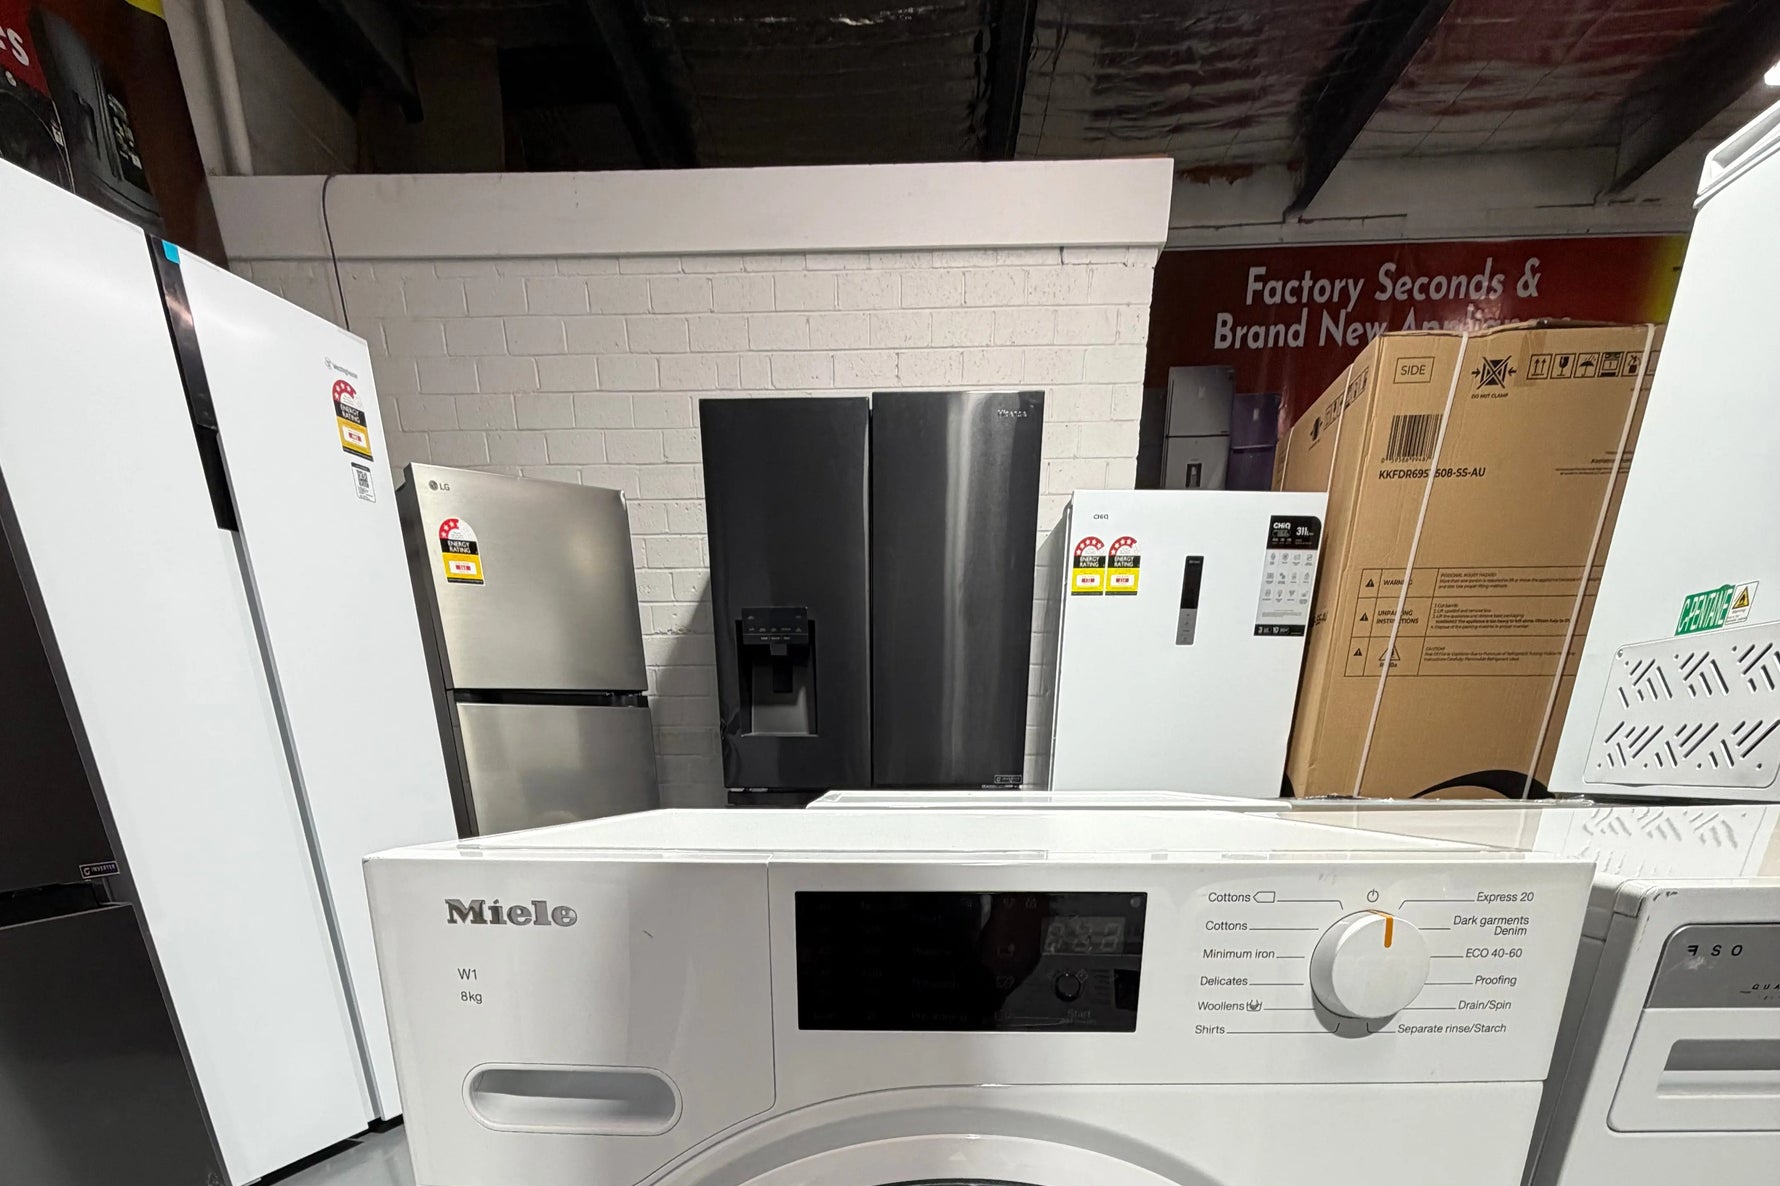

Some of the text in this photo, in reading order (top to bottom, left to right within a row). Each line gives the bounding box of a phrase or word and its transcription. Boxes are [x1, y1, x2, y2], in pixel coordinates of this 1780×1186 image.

[1246, 257, 1541, 312] Factory Seconds &
[1214, 307, 1308, 349] Brand
[1319, 308, 1387, 347] New
[1401, 364, 1426, 376] SIDE
[447, 540, 470, 548] ENERGY
[449, 546, 471, 554] RATING
[1208, 891, 1251, 902] Cottons
[1476, 891, 1534, 904] Express 20
[445, 898, 577, 927] Miele
[1205, 920, 1248, 931] Cottons
[1453, 915, 1530, 927] Dark garments
[1494, 926, 1527, 936] Denim
[1202, 948, 1275, 959] Minimum iron
[1465, 948, 1523, 958] ECO 40-60
[457, 967, 477, 980] W1
[1200, 975, 1248, 986] Delicates
[1474, 974, 1517, 987] Proofing
[460, 991, 482, 1004] 8kg
[1197, 1001, 1245, 1011] Woollens
[1458, 999, 1512, 1011] Drain/Spin
[1194, 1024, 1225, 1034] Shirts
[1397, 1023, 1507, 1035] Separate rinse/Starch
